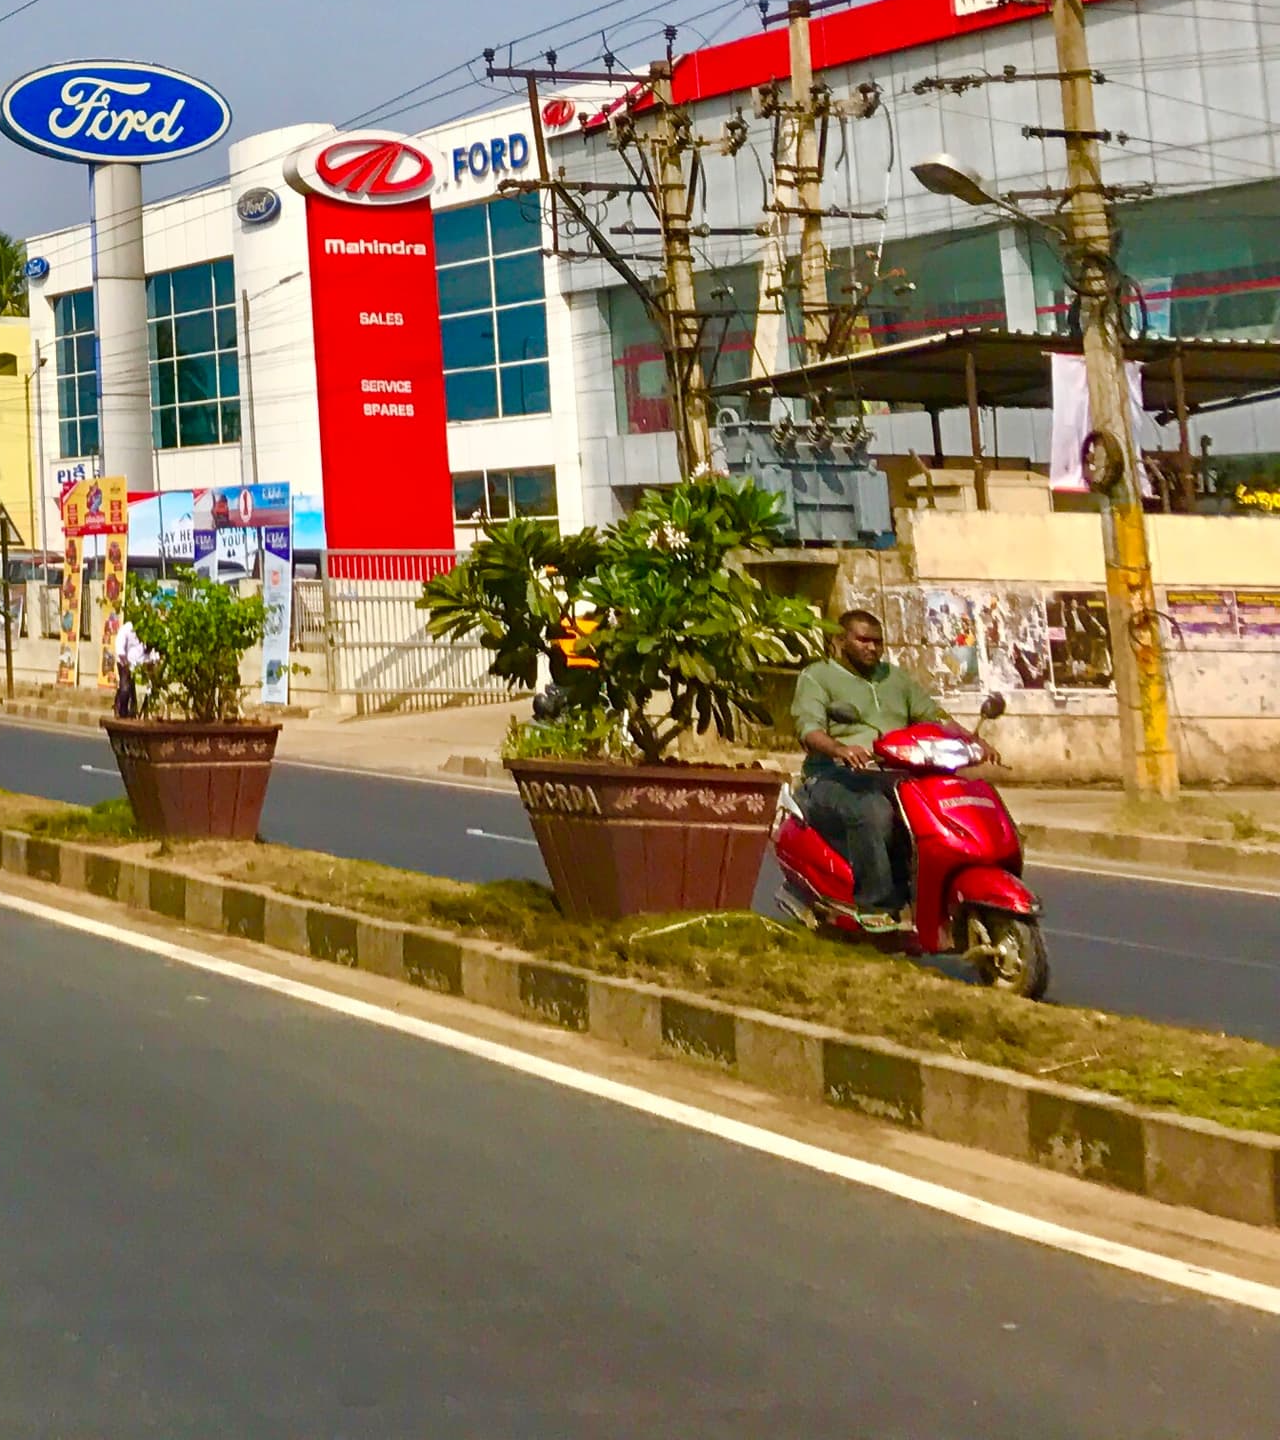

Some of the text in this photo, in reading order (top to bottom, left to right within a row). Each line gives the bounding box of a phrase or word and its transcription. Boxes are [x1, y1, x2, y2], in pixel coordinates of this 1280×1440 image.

[49, 77, 185, 143] Ford
[453, 132, 529, 182] FORD
[325, 239, 426, 255] Mahindra
[360, 312, 403, 326] SALES
[361, 379, 412, 393] SERVICE
[364, 404, 414, 416] SPARES
